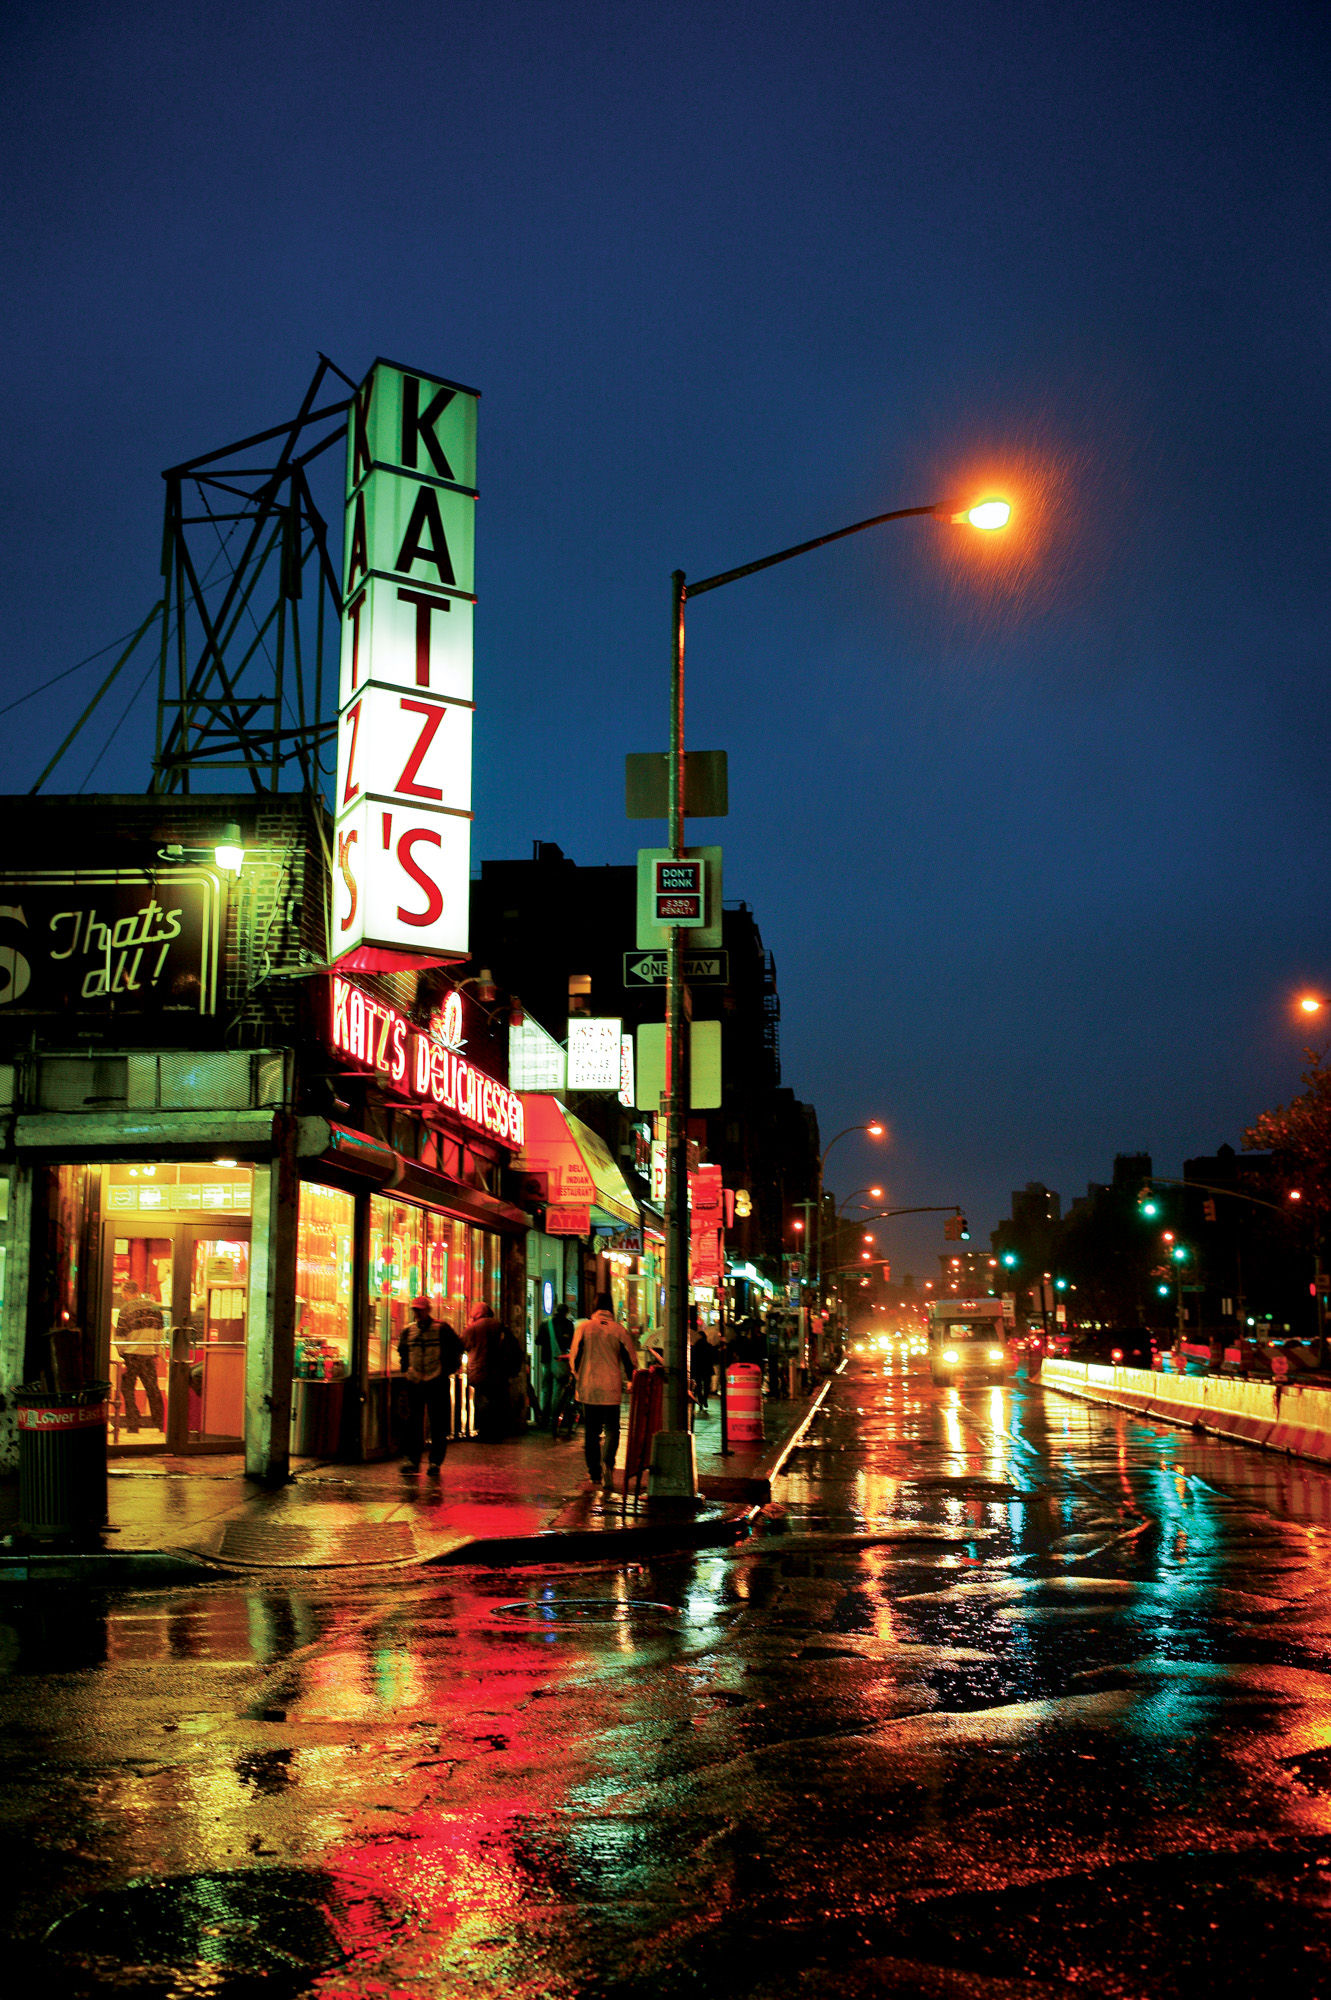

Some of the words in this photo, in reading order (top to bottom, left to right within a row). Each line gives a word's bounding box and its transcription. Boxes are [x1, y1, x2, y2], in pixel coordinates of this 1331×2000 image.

[382, 374, 457, 928] KATZ'S
[661, 868, 694, 878] DON'T
[662, 878, 694, 888] HONK
[666, 899, 690, 908] $350
[661, 907, 695, 916] PENALTY
[49, 899, 183, 961] That's
[641, 962, 668, 976] ONE
[684, 961, 714, 974] WAY
[332, 977, 407, 1081] KATZ'S
[568, 1164, 584, 1172] DELI
[566, 1176, 589, 1184] INDIAN
[548, 1214, 588, 1228] ATM
